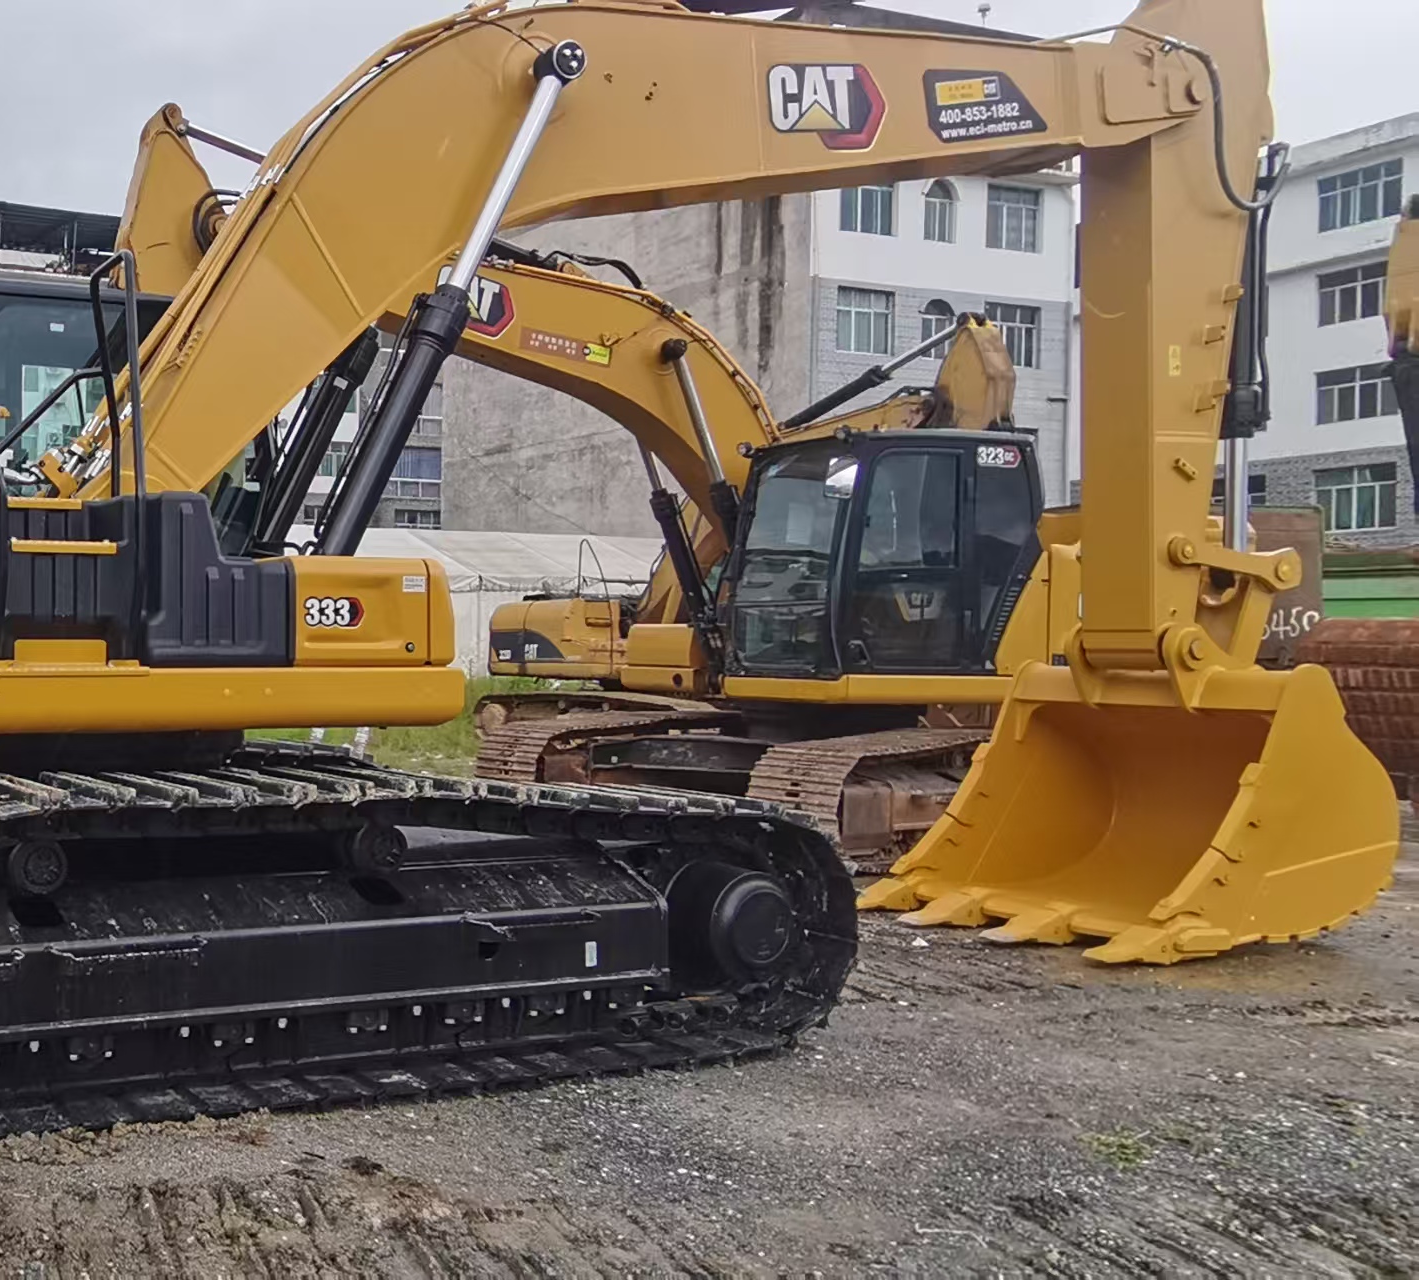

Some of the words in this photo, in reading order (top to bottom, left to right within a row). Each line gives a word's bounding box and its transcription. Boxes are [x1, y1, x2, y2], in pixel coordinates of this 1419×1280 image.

[769, 65, 854, 130] CAT
[939, 102, 1020, 124] 400-853-1882
[941, 119, 1033, 139] www.eci-metro.cn
[977, 446, 1004, 465] 323
[305, 598, 350, 626] 333
